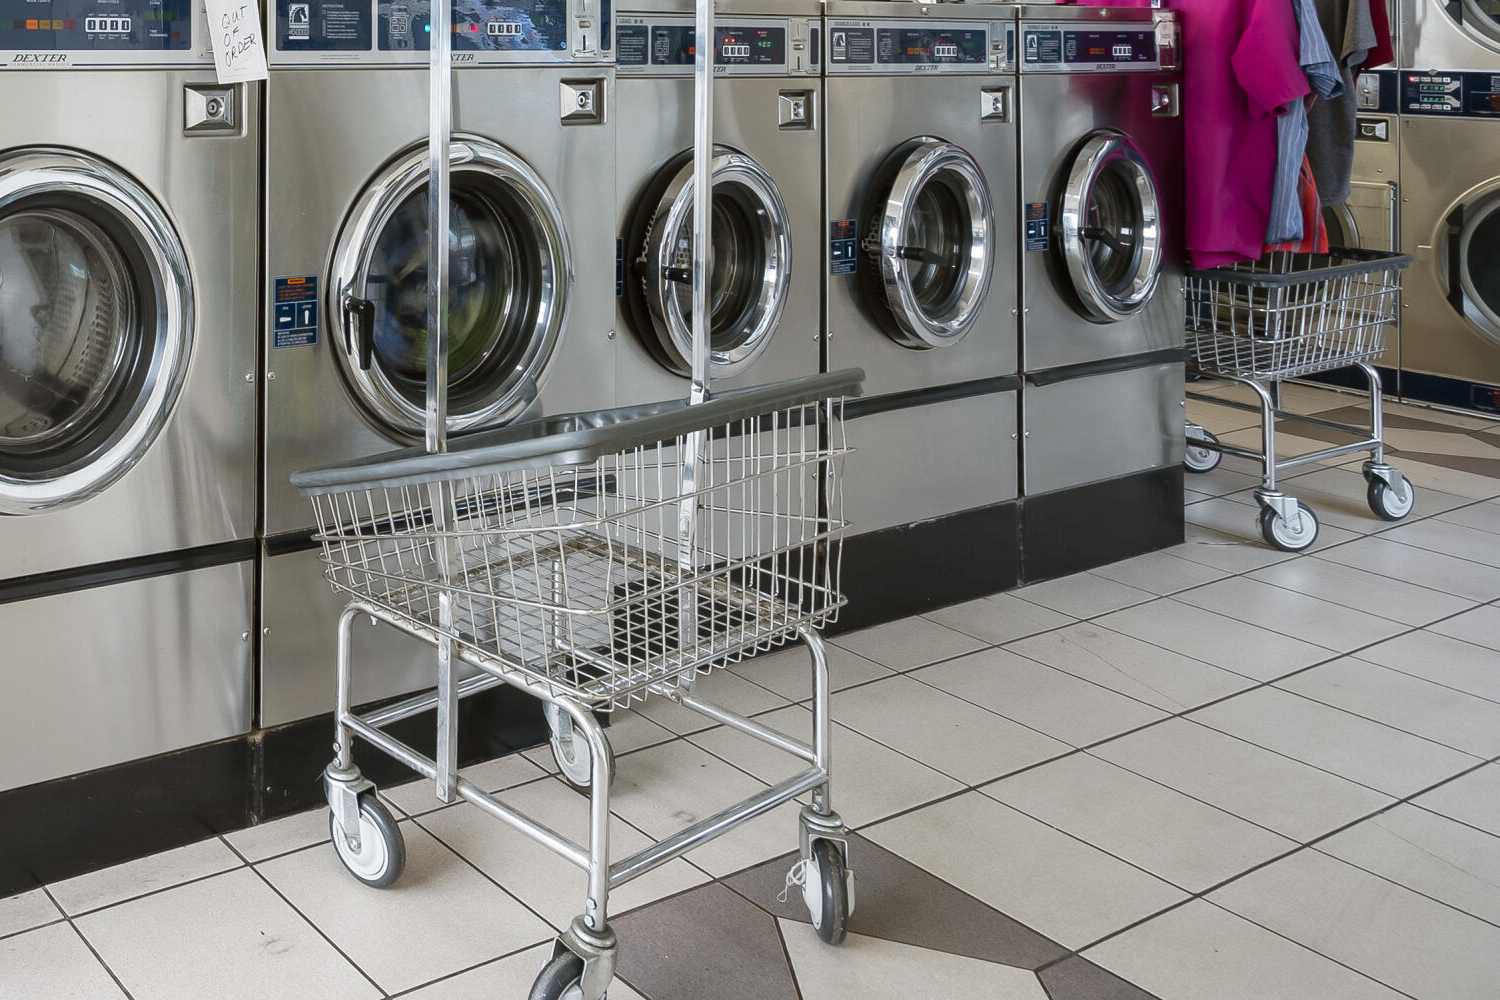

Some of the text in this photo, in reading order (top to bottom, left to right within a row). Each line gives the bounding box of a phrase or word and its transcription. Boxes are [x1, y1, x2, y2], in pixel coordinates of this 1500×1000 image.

[222, 5, 248, 29] OUT
[224, 26, 240, 47] OF
[12, 53, 67, 63] DEXTER
[225, 33, 256, 67] ORDER
[451, 53, 475, 61] XTER
